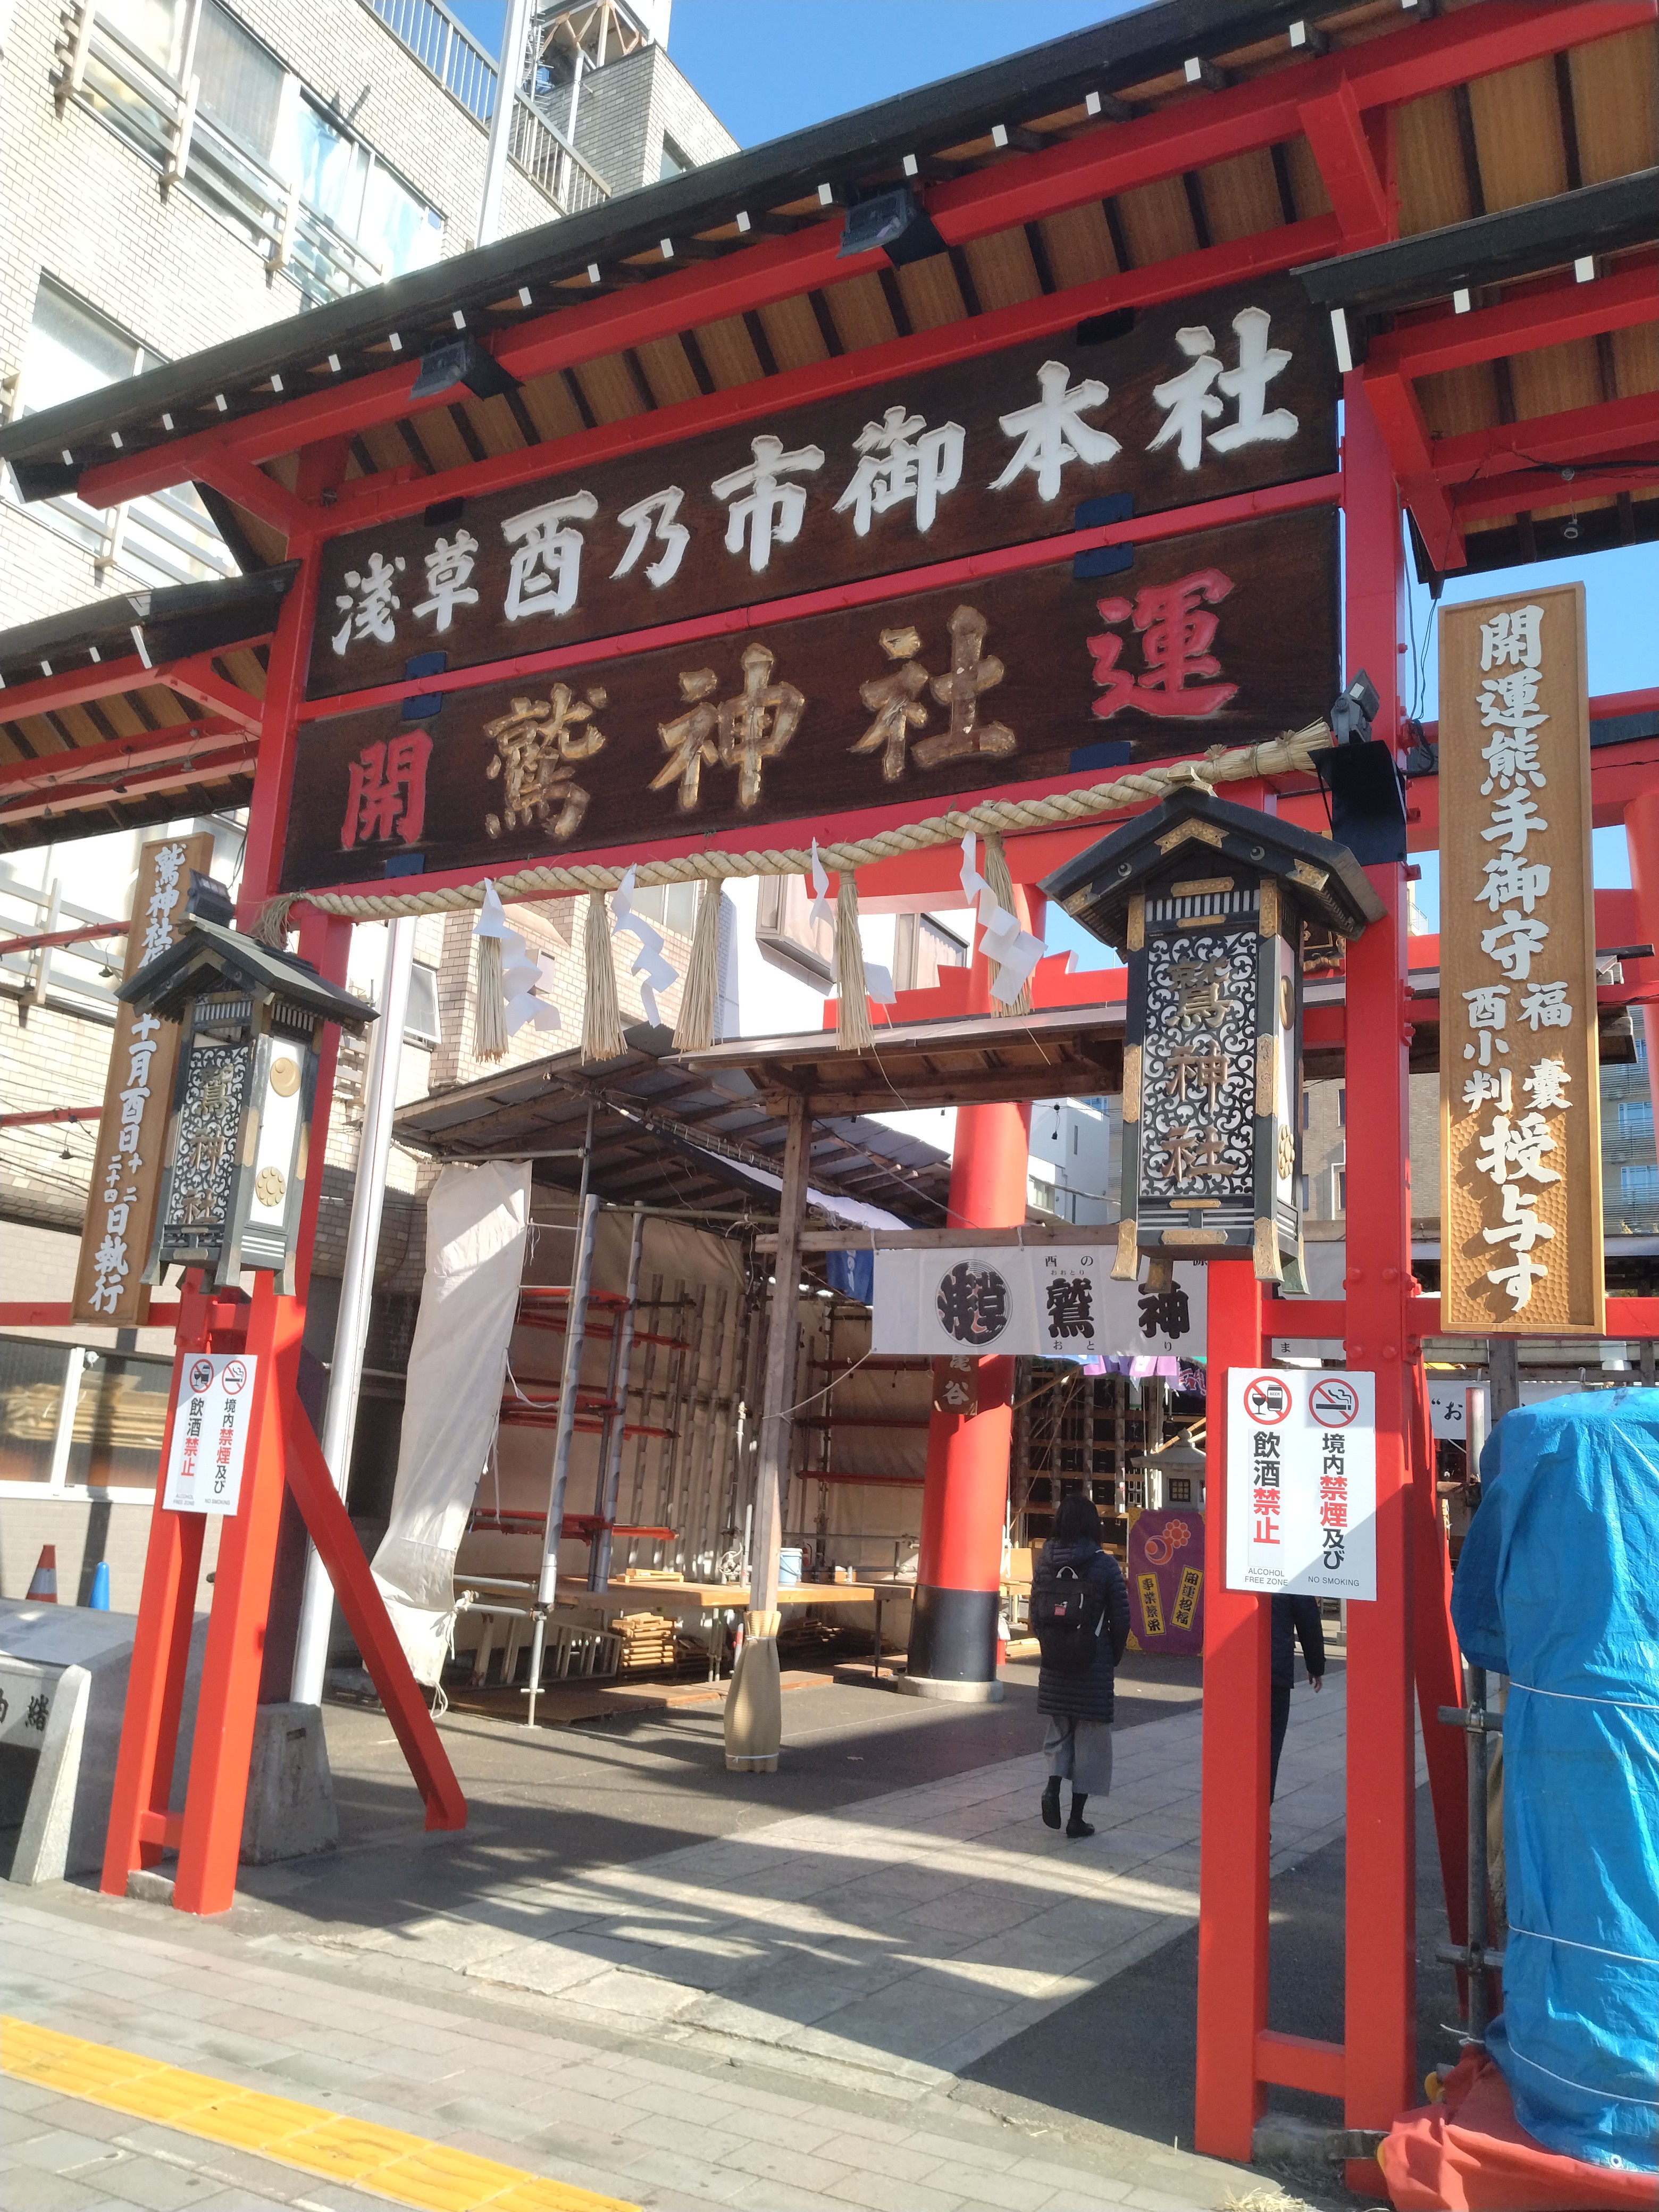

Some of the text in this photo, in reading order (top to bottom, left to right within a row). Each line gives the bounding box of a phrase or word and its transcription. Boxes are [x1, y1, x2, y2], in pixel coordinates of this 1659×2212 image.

[1161, 957, 1237, 1184] 鷲神社
[181, 1397, 205, 1477] 飲酒禁止
[214, 1398, 237, 1494] 境内禁煙及び
[1253, 1431, 1280, 1545] 飲酒禁止
[1320, 1432, 1348, 1570] 境内禁煙及び
[1245, 1576, 1288, 1586] FREE ZONE
[1248, 1568, 1285, 1577] ALCOHOL
[1322, 1577, 1360, 1587] SMOKING
